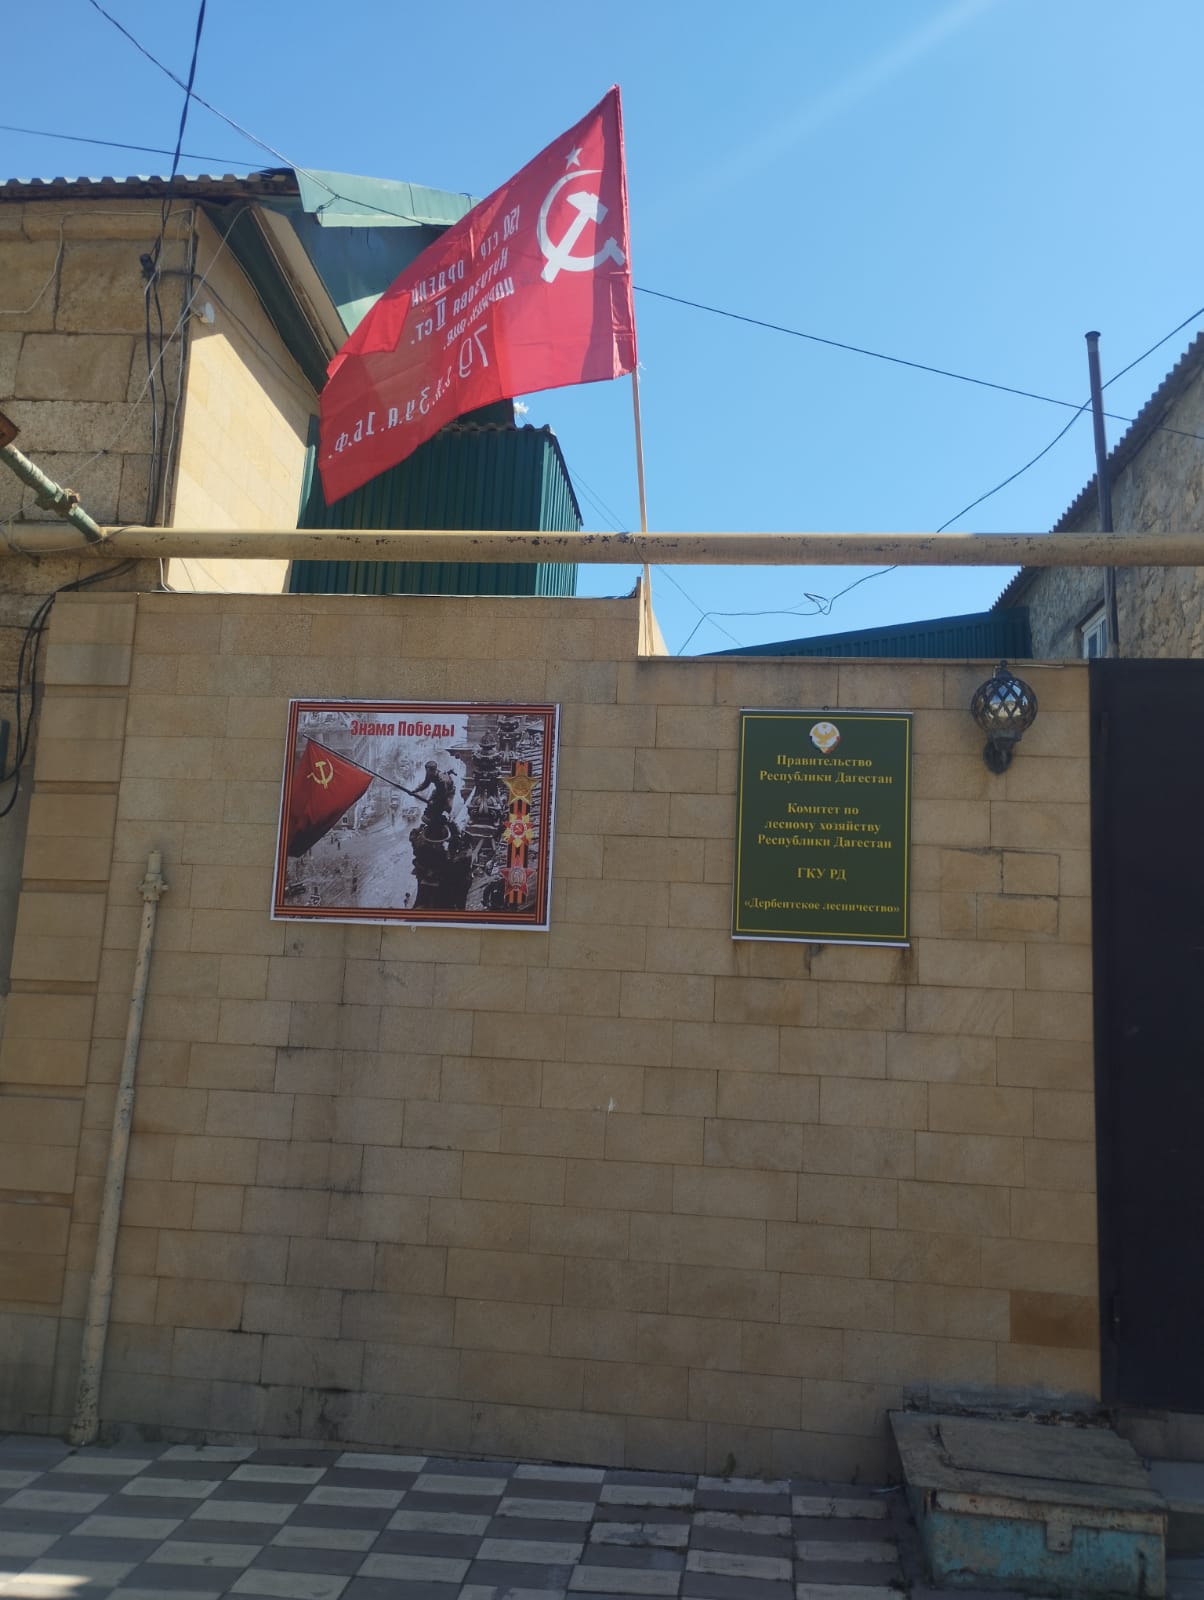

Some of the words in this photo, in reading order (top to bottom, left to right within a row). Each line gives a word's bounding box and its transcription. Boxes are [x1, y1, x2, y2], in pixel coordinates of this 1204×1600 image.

[350, 720, 395, 736] Знамя
[397, 720, 455, 739] Победы
[776, 754, 873, 768] Правительство
[759, 770, 832, 784] Республики
[834, 771, 893, 785] Дагестан
[787, 802, 841, 815] Комитет
[844, 806, 860, 816] по
[764, 820, 817, 833] лесному
[819, 820, 881, 835] хозяйству
[757, 834, 831, 848] Республики
[833, 836, 893, 850] Дагестан
[797, 866, 826, 879] ГКУ
[829, 868, 847, 881] РД
[744, 897, 820, 911] «Дербентское
[822, 902, 900, 914] лесничество»
